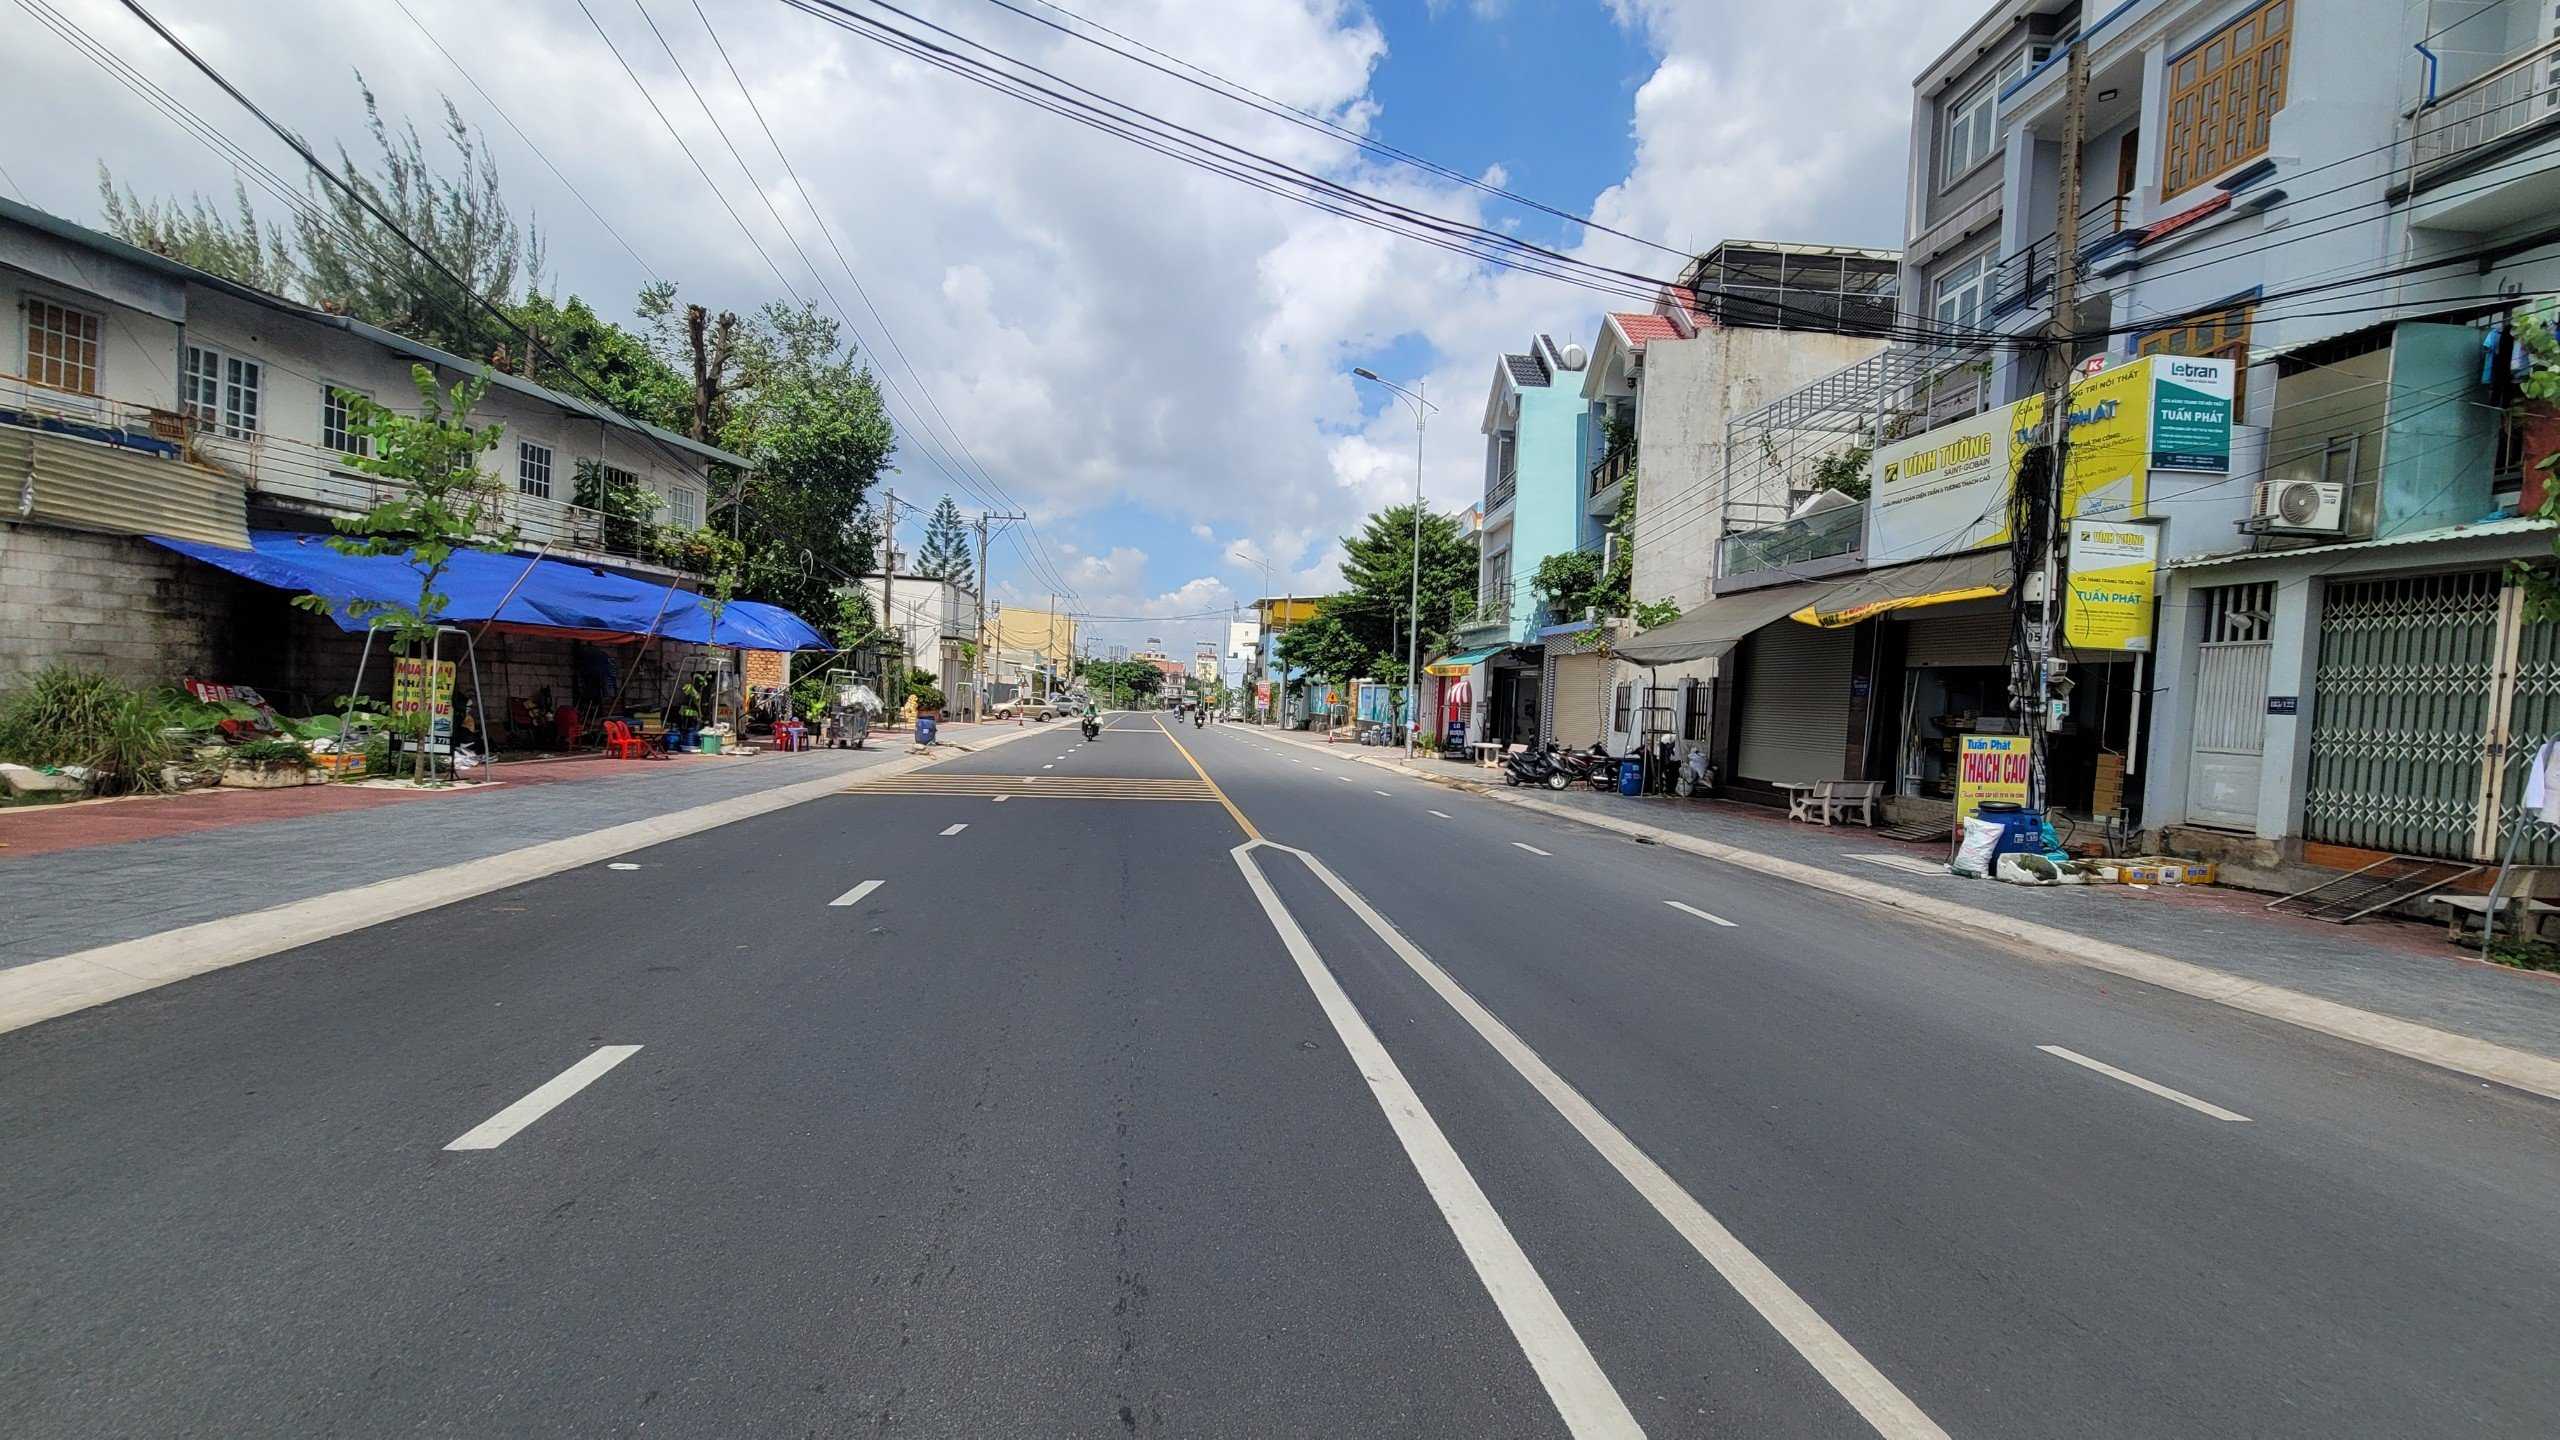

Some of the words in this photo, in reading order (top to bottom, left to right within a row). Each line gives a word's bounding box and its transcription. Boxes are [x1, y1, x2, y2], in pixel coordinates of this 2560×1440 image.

[2086, 382, 2098, 393] TRÍ
[2117, 370, 2139, 385] THẤT
[2161, 407, 2192, 421] TUẤN
[2195, 410, 2224, 423] PHÁT
[1904, 450, 1937, 478] VĨNH
[1940, 433, 1991, 468] TƯỜNG
[1944, 457, 1990, 476] SAINT-GOBAIN
[2077, 588, 2109, 602] TUẤN
[2112, 592, 2142, 604] PHÁT
[2004, 754, 2026, 784] CAO
